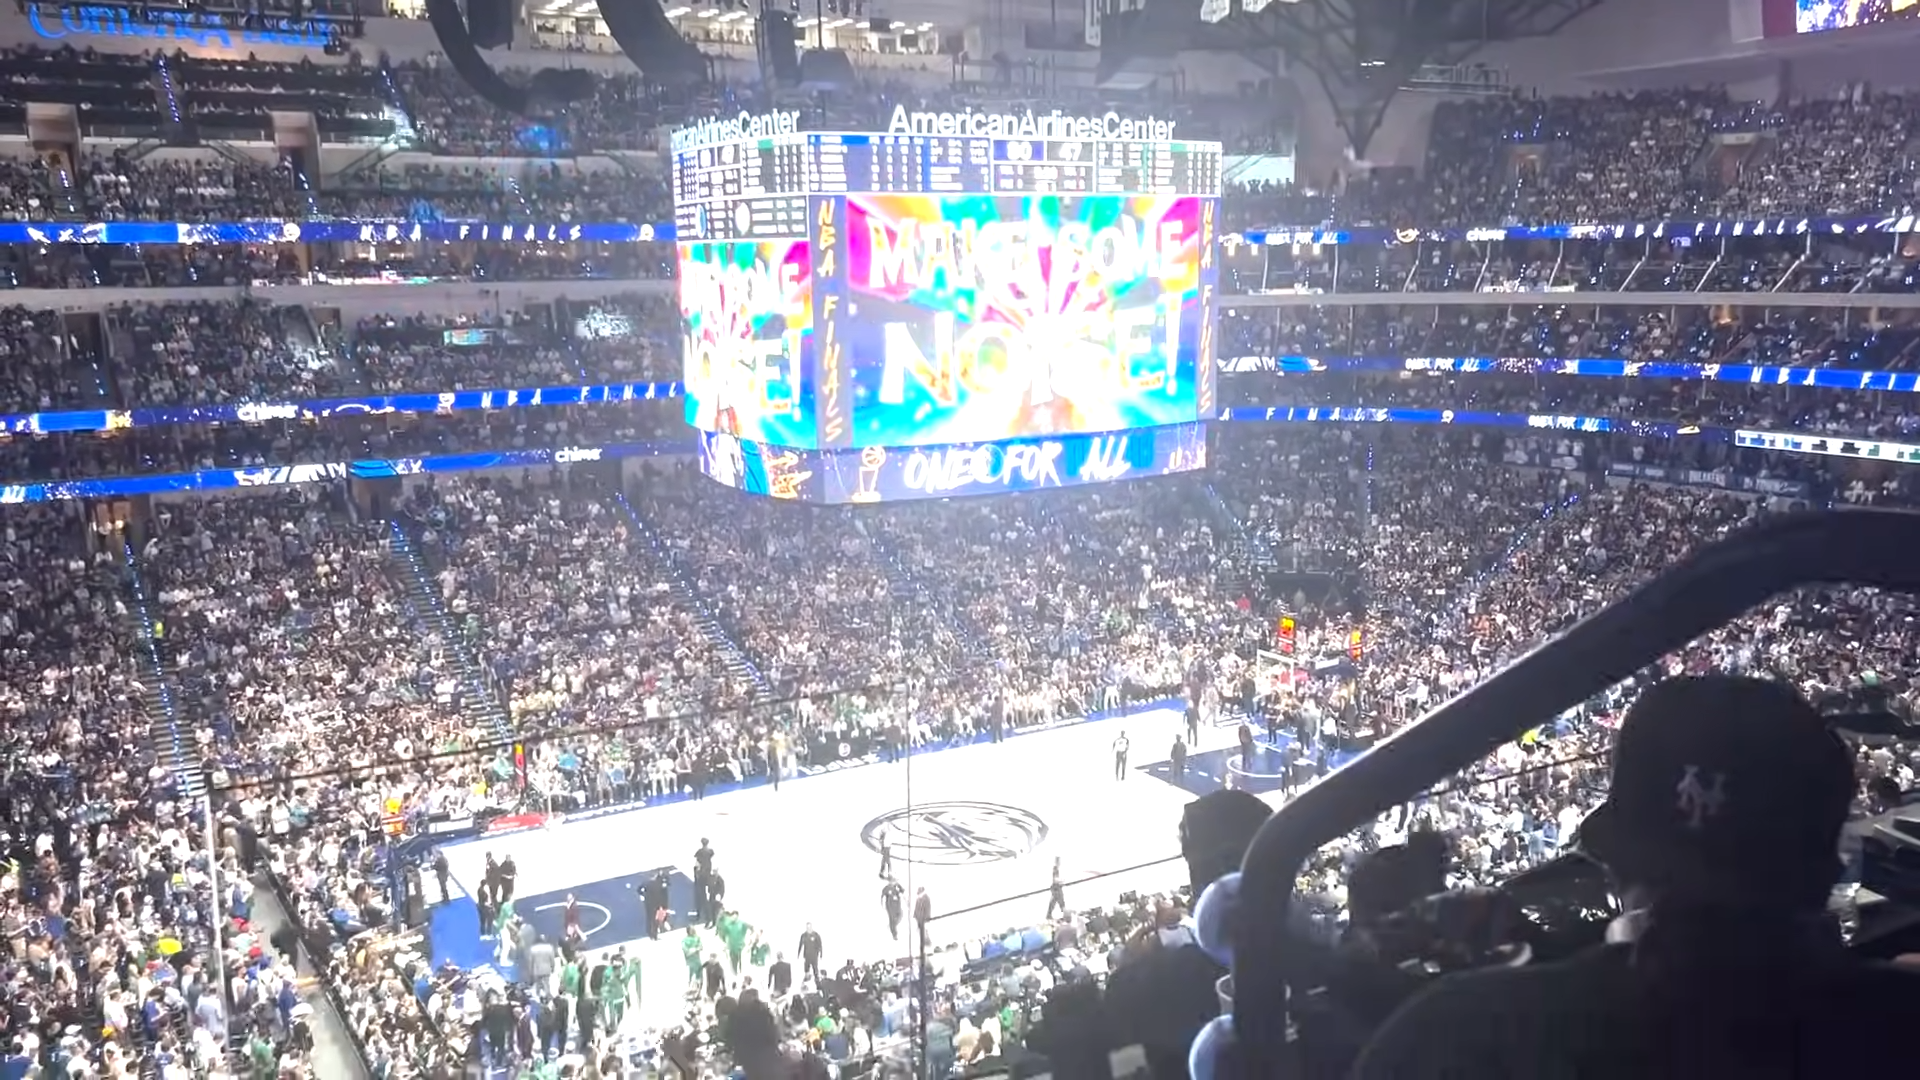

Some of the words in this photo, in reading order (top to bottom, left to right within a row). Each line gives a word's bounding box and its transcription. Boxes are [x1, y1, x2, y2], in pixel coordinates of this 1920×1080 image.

[360, 224, 421, 242] NBA
[460, 224, 581, 241] FINALS
[817, 198, 836, 277] NBA
[1466, 227, 1507, 241] chime
[1614, 223, 1664, 239] NBA
[1695, 219, 1808, 236] FINALS
[822, 295, 843, 442] FINALS
[1751, 366, 1815, 386] NBA
[481, 388, 542, 408] NBA
[237, 400, 298, 421] chime
[1266, 407, 1389, 421] FINALS
[555, 445, 602, 463] chime
[904, 449, 975, 493] ONE
[1003, 441, 1062, 486] FOR
[1080, 435, 1131, 480] ALL
